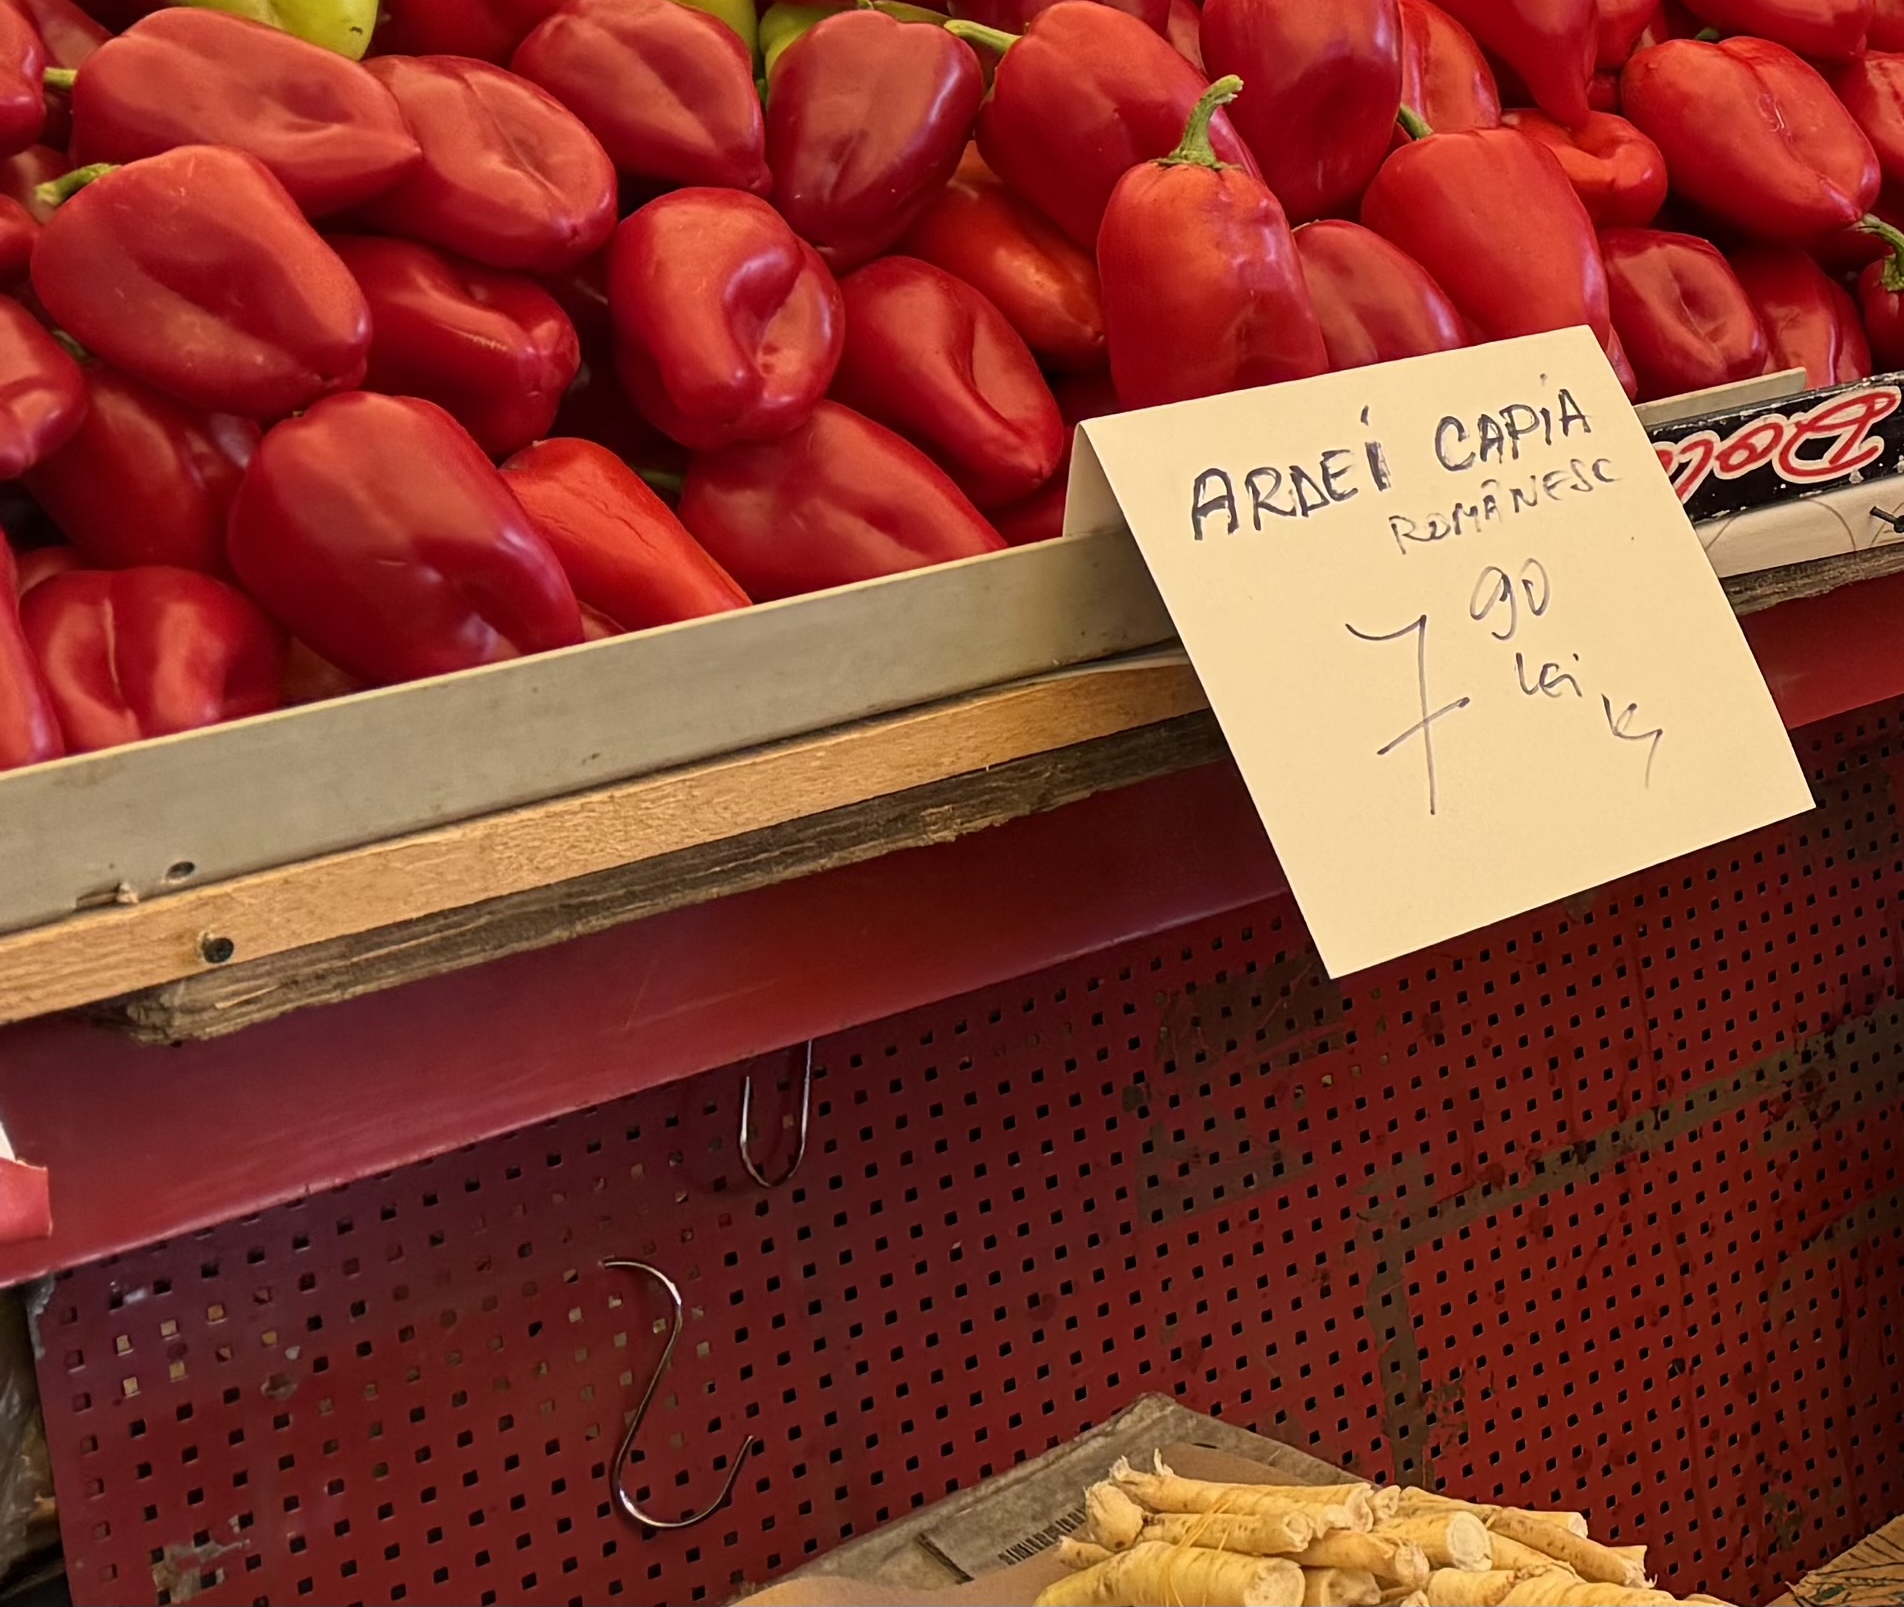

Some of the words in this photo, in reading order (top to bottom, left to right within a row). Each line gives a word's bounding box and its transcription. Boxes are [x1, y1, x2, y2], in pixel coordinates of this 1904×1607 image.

[1190, 404, 1393, 542] ARDEI
[1434, 374, 1592, 472] CAPIA
[1388, 458, 1618, 555] ROMÂNESC
[1469, 557, 1551, 641] 90
[1344, 613, 1471, 816] 7
